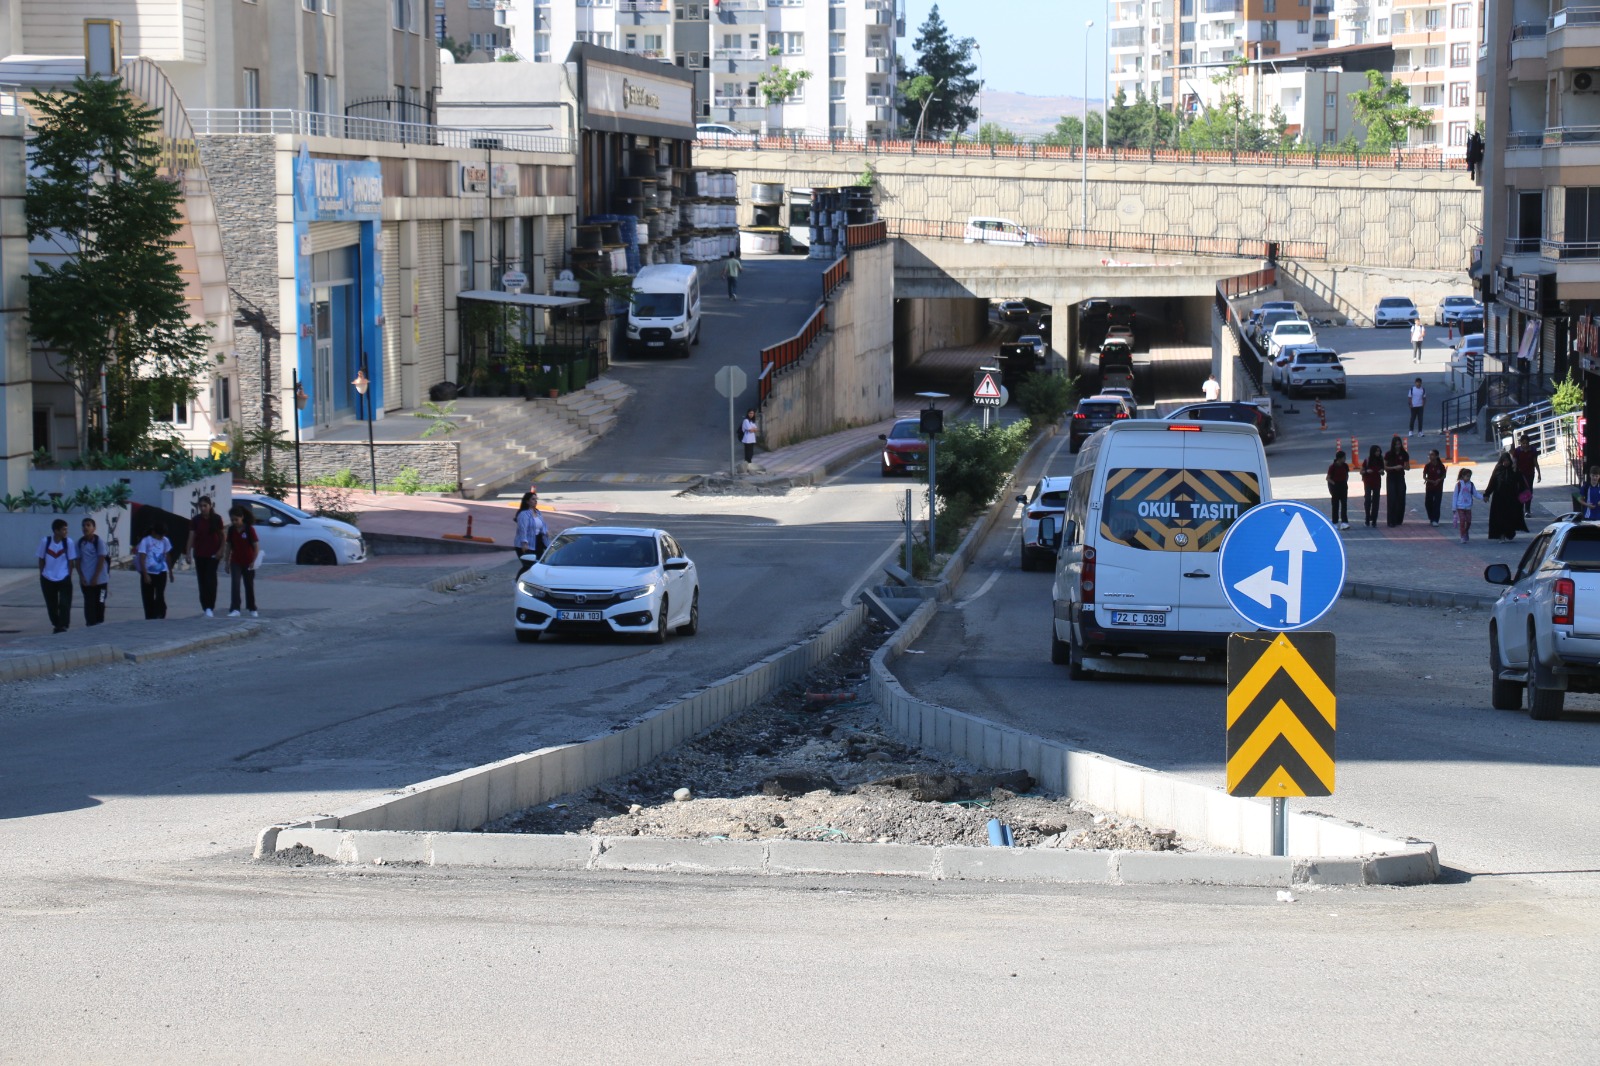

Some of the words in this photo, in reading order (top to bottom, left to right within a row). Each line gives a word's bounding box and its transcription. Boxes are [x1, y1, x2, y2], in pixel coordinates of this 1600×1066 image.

[1138, 502, 1180, 518] OKUL
[1190, 504, 1239, 521] TAŞITI
[561, 612, 570, 620] 52
[573, 612, 585, 620] AAH
[588, 612, 600, 620] 103
[1117, 613, 1128, 622] 72
[1132, 613, 1138, 622] C
[1143, 614, 1164, 623] 0399
